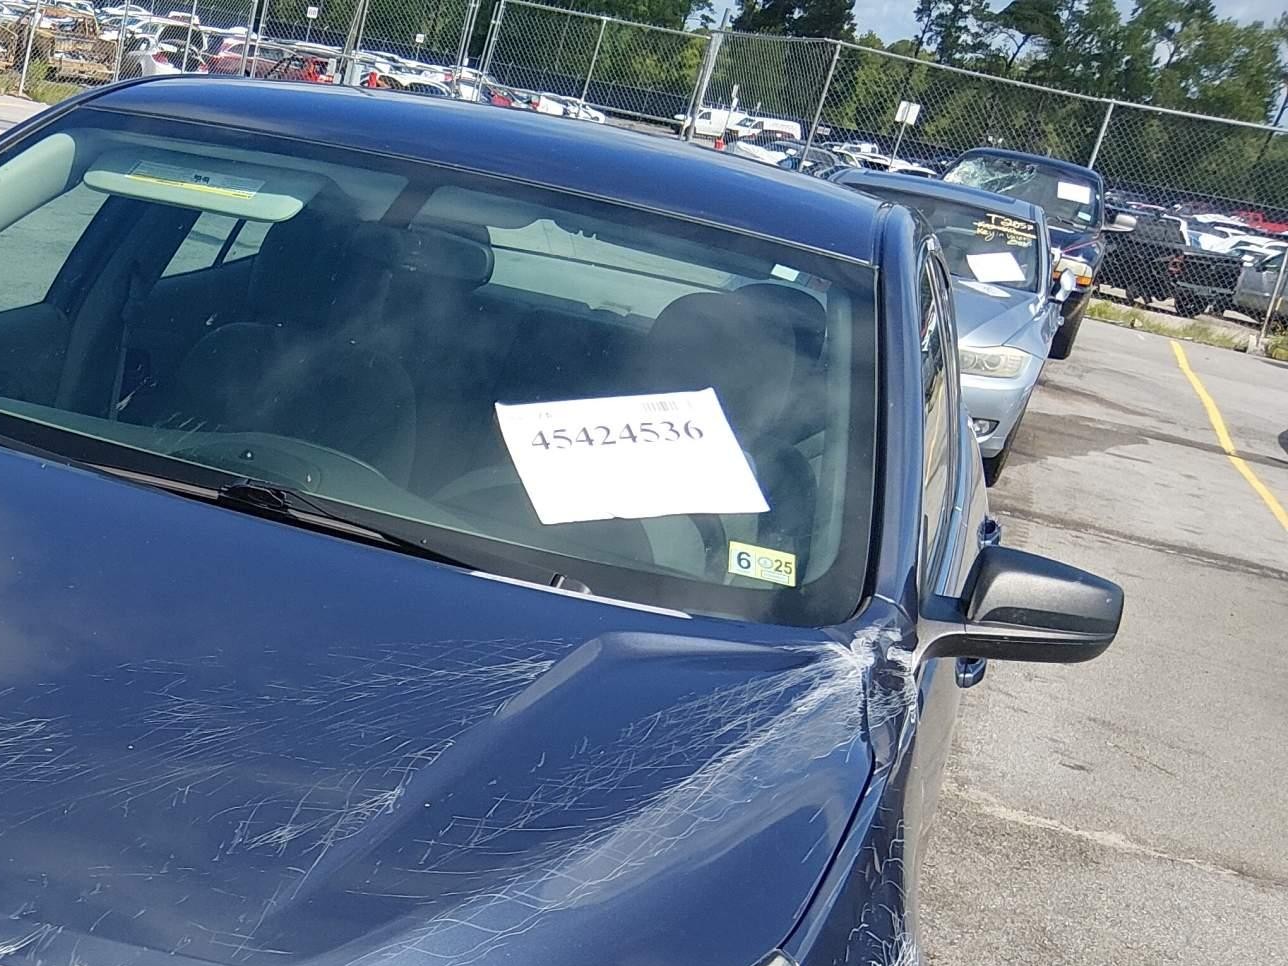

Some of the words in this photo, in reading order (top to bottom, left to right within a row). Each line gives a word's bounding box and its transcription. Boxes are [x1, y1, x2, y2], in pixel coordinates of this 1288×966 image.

[531, 420, 704, 449] 45424536
[736, 551, 752, 570] 6
[774, 559, 793, 575] 25
